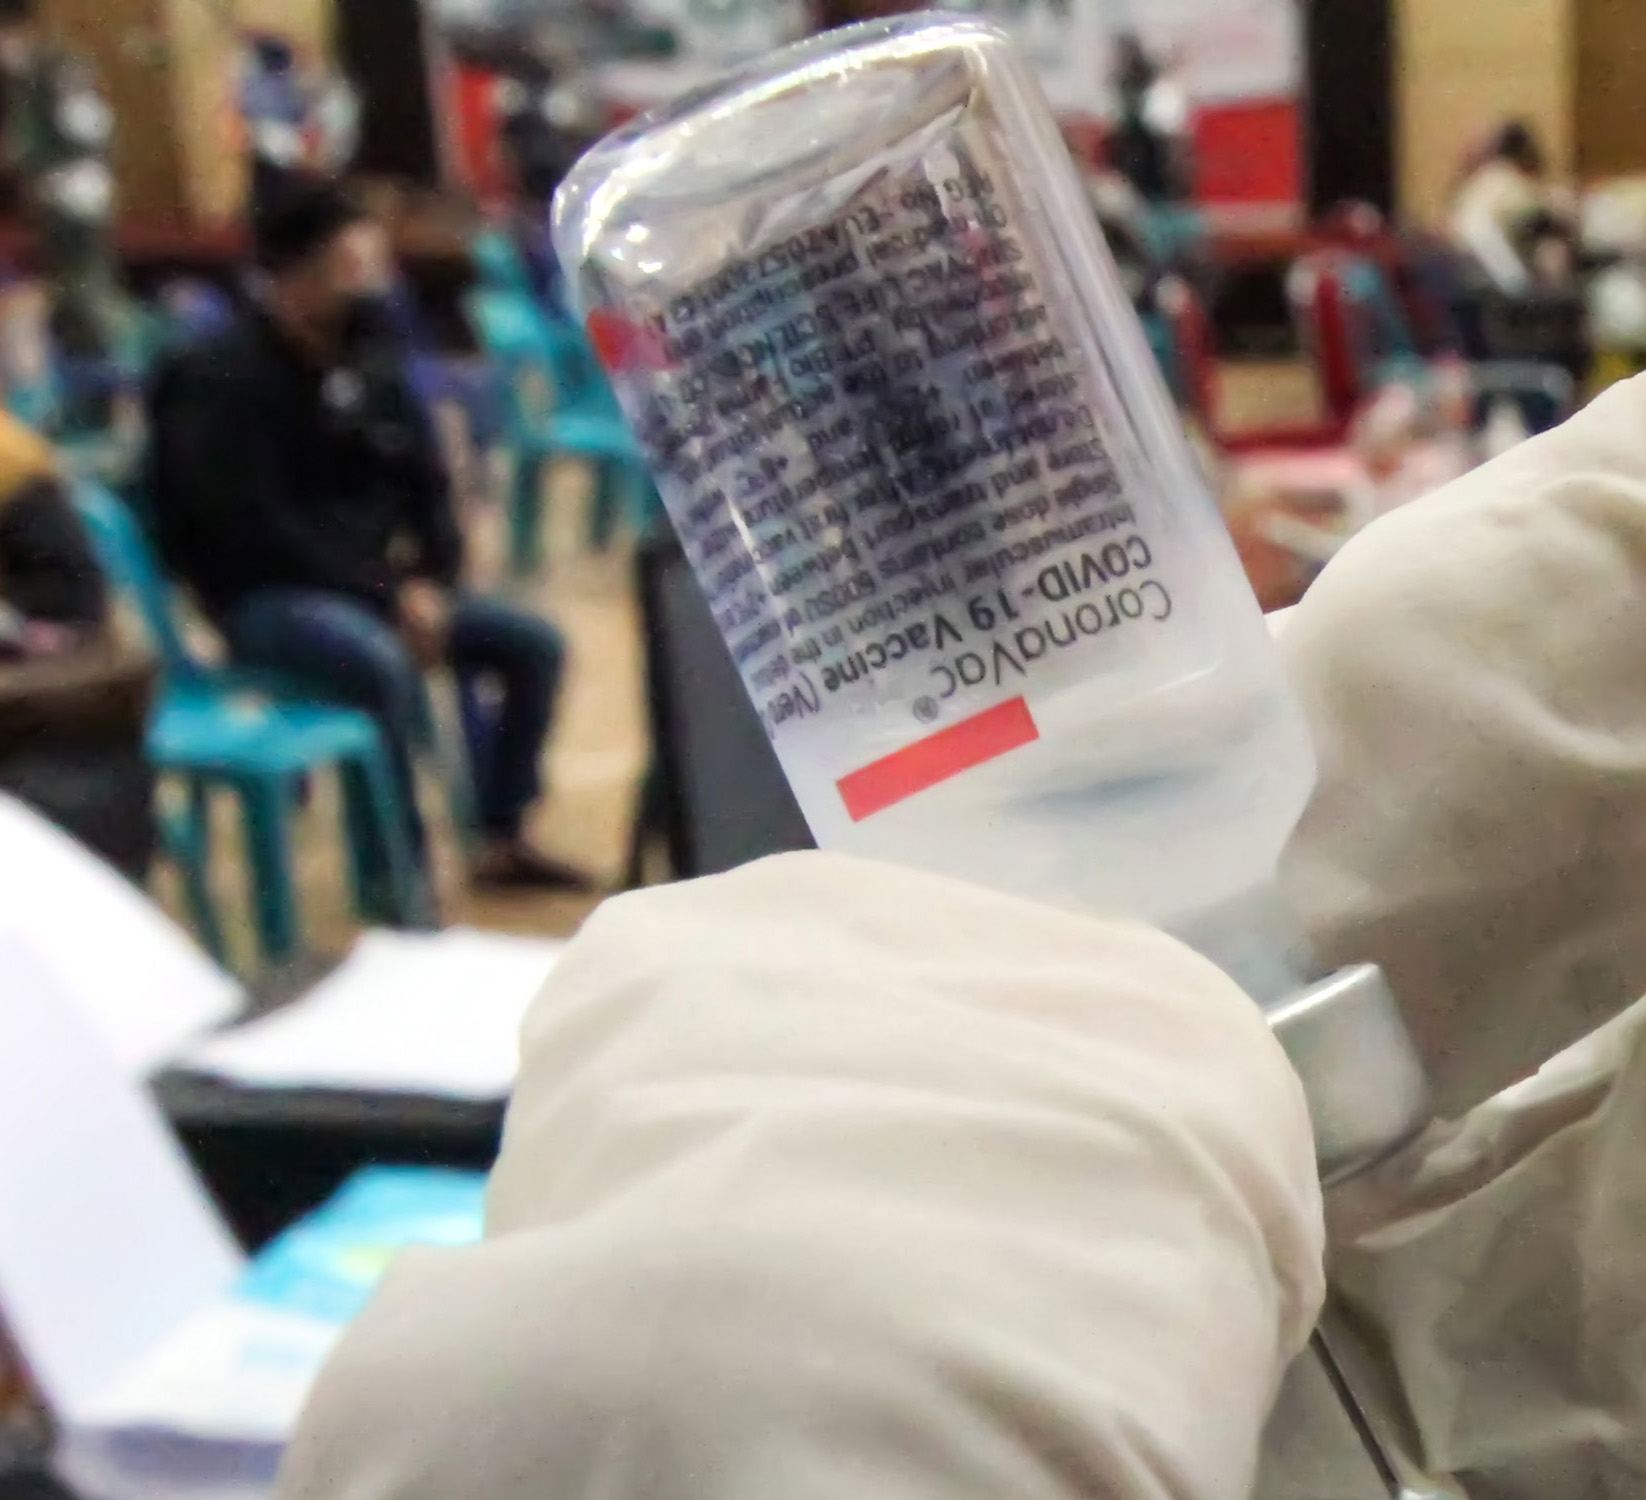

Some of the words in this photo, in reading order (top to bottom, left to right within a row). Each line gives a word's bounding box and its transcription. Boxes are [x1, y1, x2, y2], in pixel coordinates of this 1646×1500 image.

[964, 504, 1133, 584] Intramuscular
[990, 496, 1051, 535] dose
[850, 573, 956, 635] injection
[967, 535, 1154, 629] COVID-19
[820, 625, 845, 650] in
[822, 610, 963, 693] Vaccine
